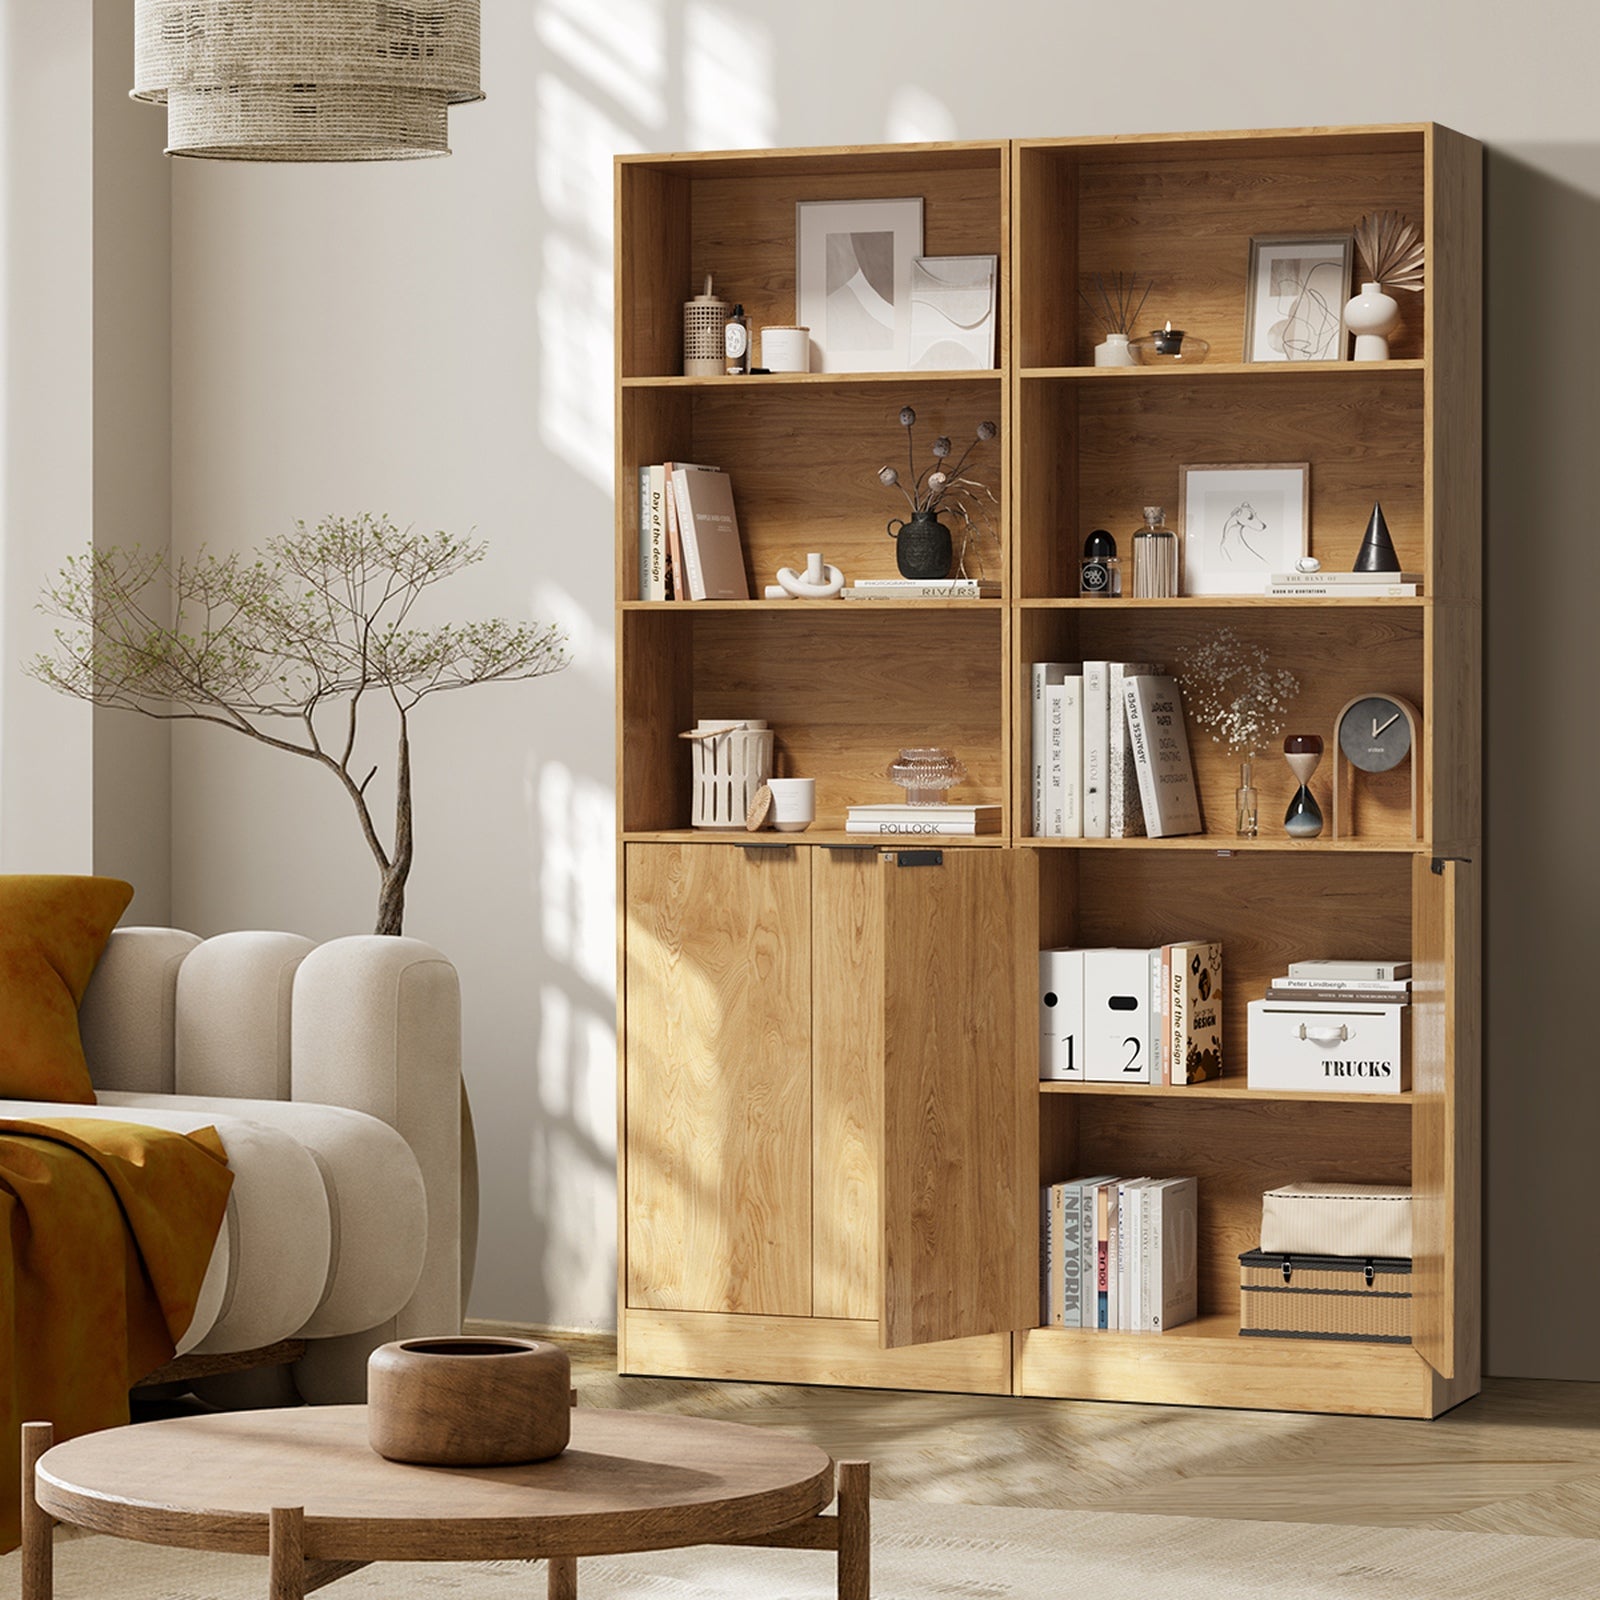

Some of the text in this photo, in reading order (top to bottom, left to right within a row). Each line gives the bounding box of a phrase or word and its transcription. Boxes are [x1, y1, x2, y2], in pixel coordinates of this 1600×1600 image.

[652, 491, 662, 582] Day of the design
[921, 587, 976, 596] RIVERS
[1052, 698, 1061, 787] ART IN THE AFTER CULTURE
[1127, 692, 1147, 764] JAPANESE PAPER
[879, 823, 940, 834] POLLOCK
[1308, 981, 1347, 989] Lindbergh
[1173, 974, 1183, 1065] Day of the design
[1193, 1015, 1217, 1030] DESIGN
[1061, 1034, 1080, 1071] 1
[1122, 1037, 1144, 1073] 2
[1321, 1060, 1392, 1077] TRUCKS
[1064, 1195, 1080, 1312] NEW YORK
